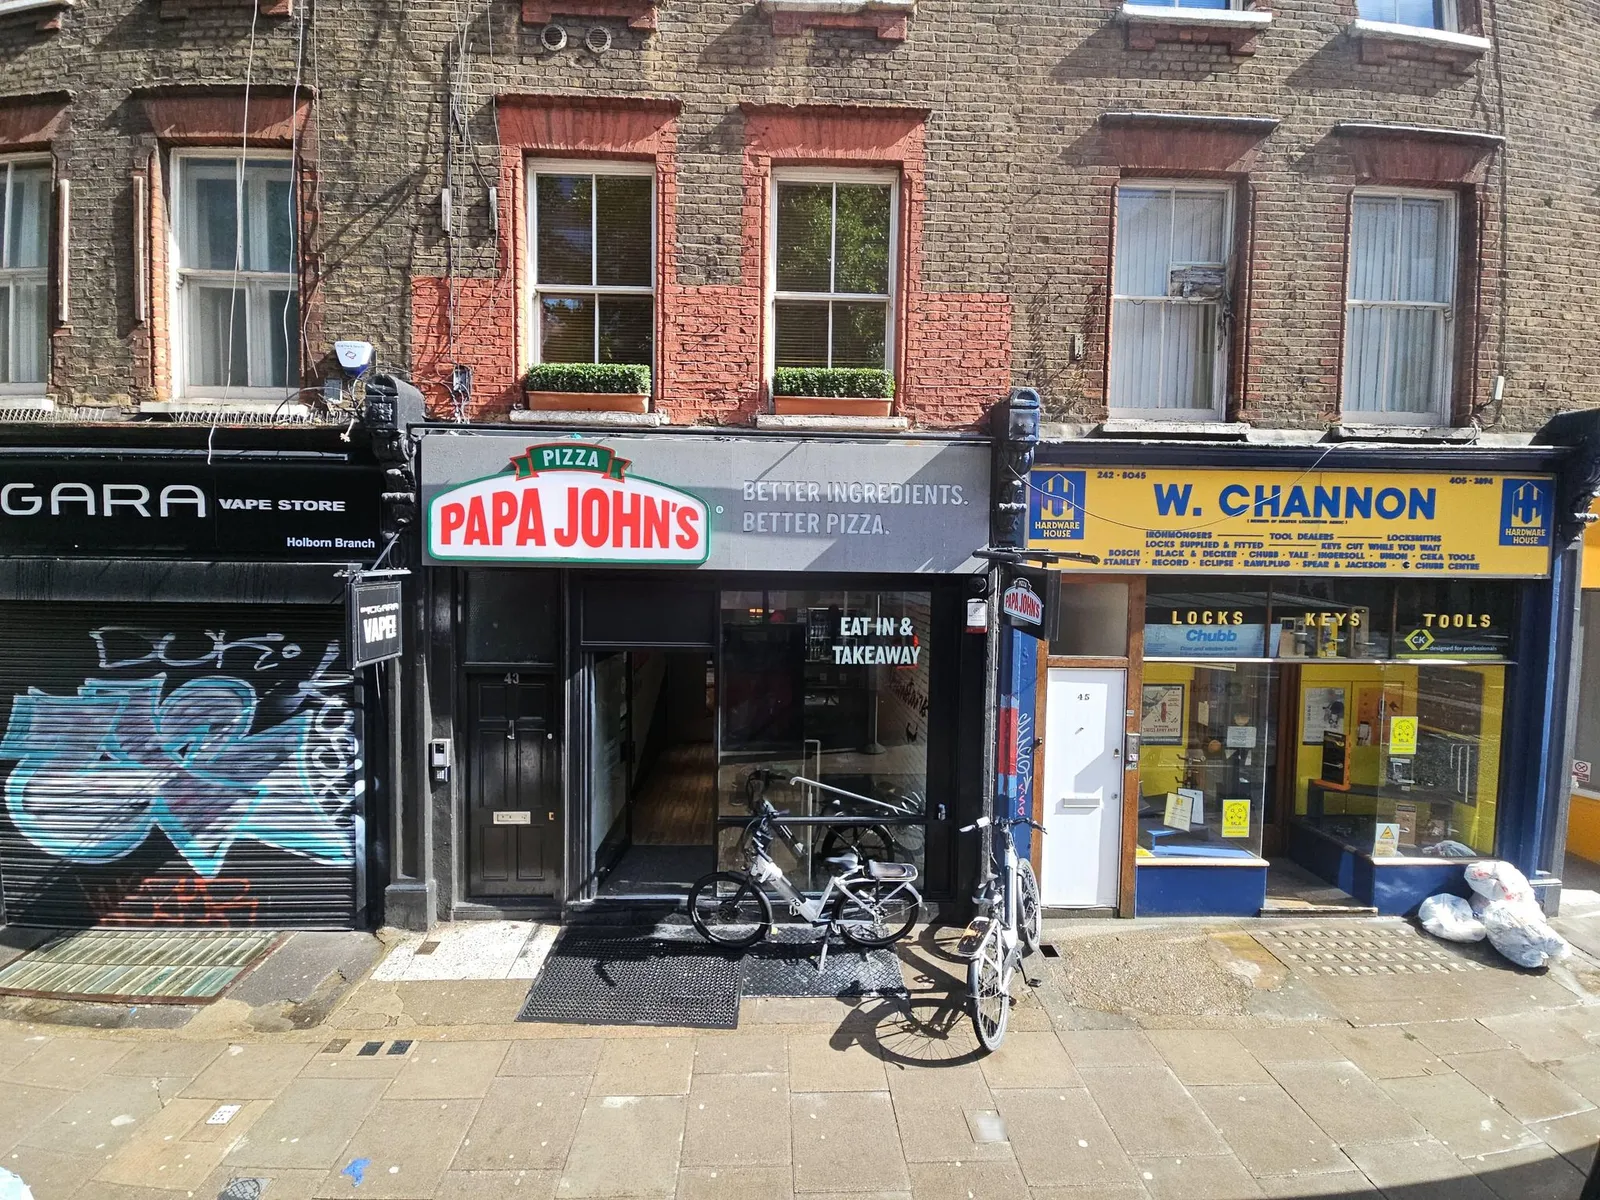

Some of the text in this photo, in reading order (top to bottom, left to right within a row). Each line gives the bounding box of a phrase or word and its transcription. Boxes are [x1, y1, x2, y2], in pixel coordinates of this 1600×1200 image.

[543, 449, 599, 468] PIZZA
[1097, 471, 1146, 479] 242 8045
[0, 482, 206, 518] GARA
[743, 480, 969, 506] BETTER INGREDIENTS.
[218, 498, 346, 512] VAPE STORE
[1153, 484, 1436, 520] W. CHANNON
[441, 487, 699, 549] PAPA JOHN'S
[743, 511, 890, 535] BETTER PIZZA.
[1035, 521, 1080, 530] HARDWARE
[1505, 528, 1546, 536] HARDWARE
[1043, 529, 1071, 538] HOUSE
[1146, 531, 1212, 539] IRONMONGERS
[1513, 536, 1538, 544] HOUSE
[287, 536, 375, 549] Holborn Branch
[1145, 540, 1175, 548] LOCKS
[1234, 541, 1264, 549] FITTED
[1368, 543, 1394, 551] WHILE
[1109, 549, 1140, 557] BOSCH
[1202, 550, 1237, 558] DECKER
[1103, 558, 1141, 566] STANLEY
[1199, 559, 1234, 567] ECLIPSE
[1345, 561, 1387, 569] JACKSON
[1006, 592, 1019, 611] PAPA
[1172, 610, 1243, 625] LOCKS
[1305, 612, 1360, 626] KEYS
[1422, 613, 1491, 628] TOOLS
[840, 617, 913, 635] EAT IN &
[1186, 629, 1237, 642] Chubb
[832, 645, 921, 664] TAKEAWAY
[504, 672, 519, 684] 43
